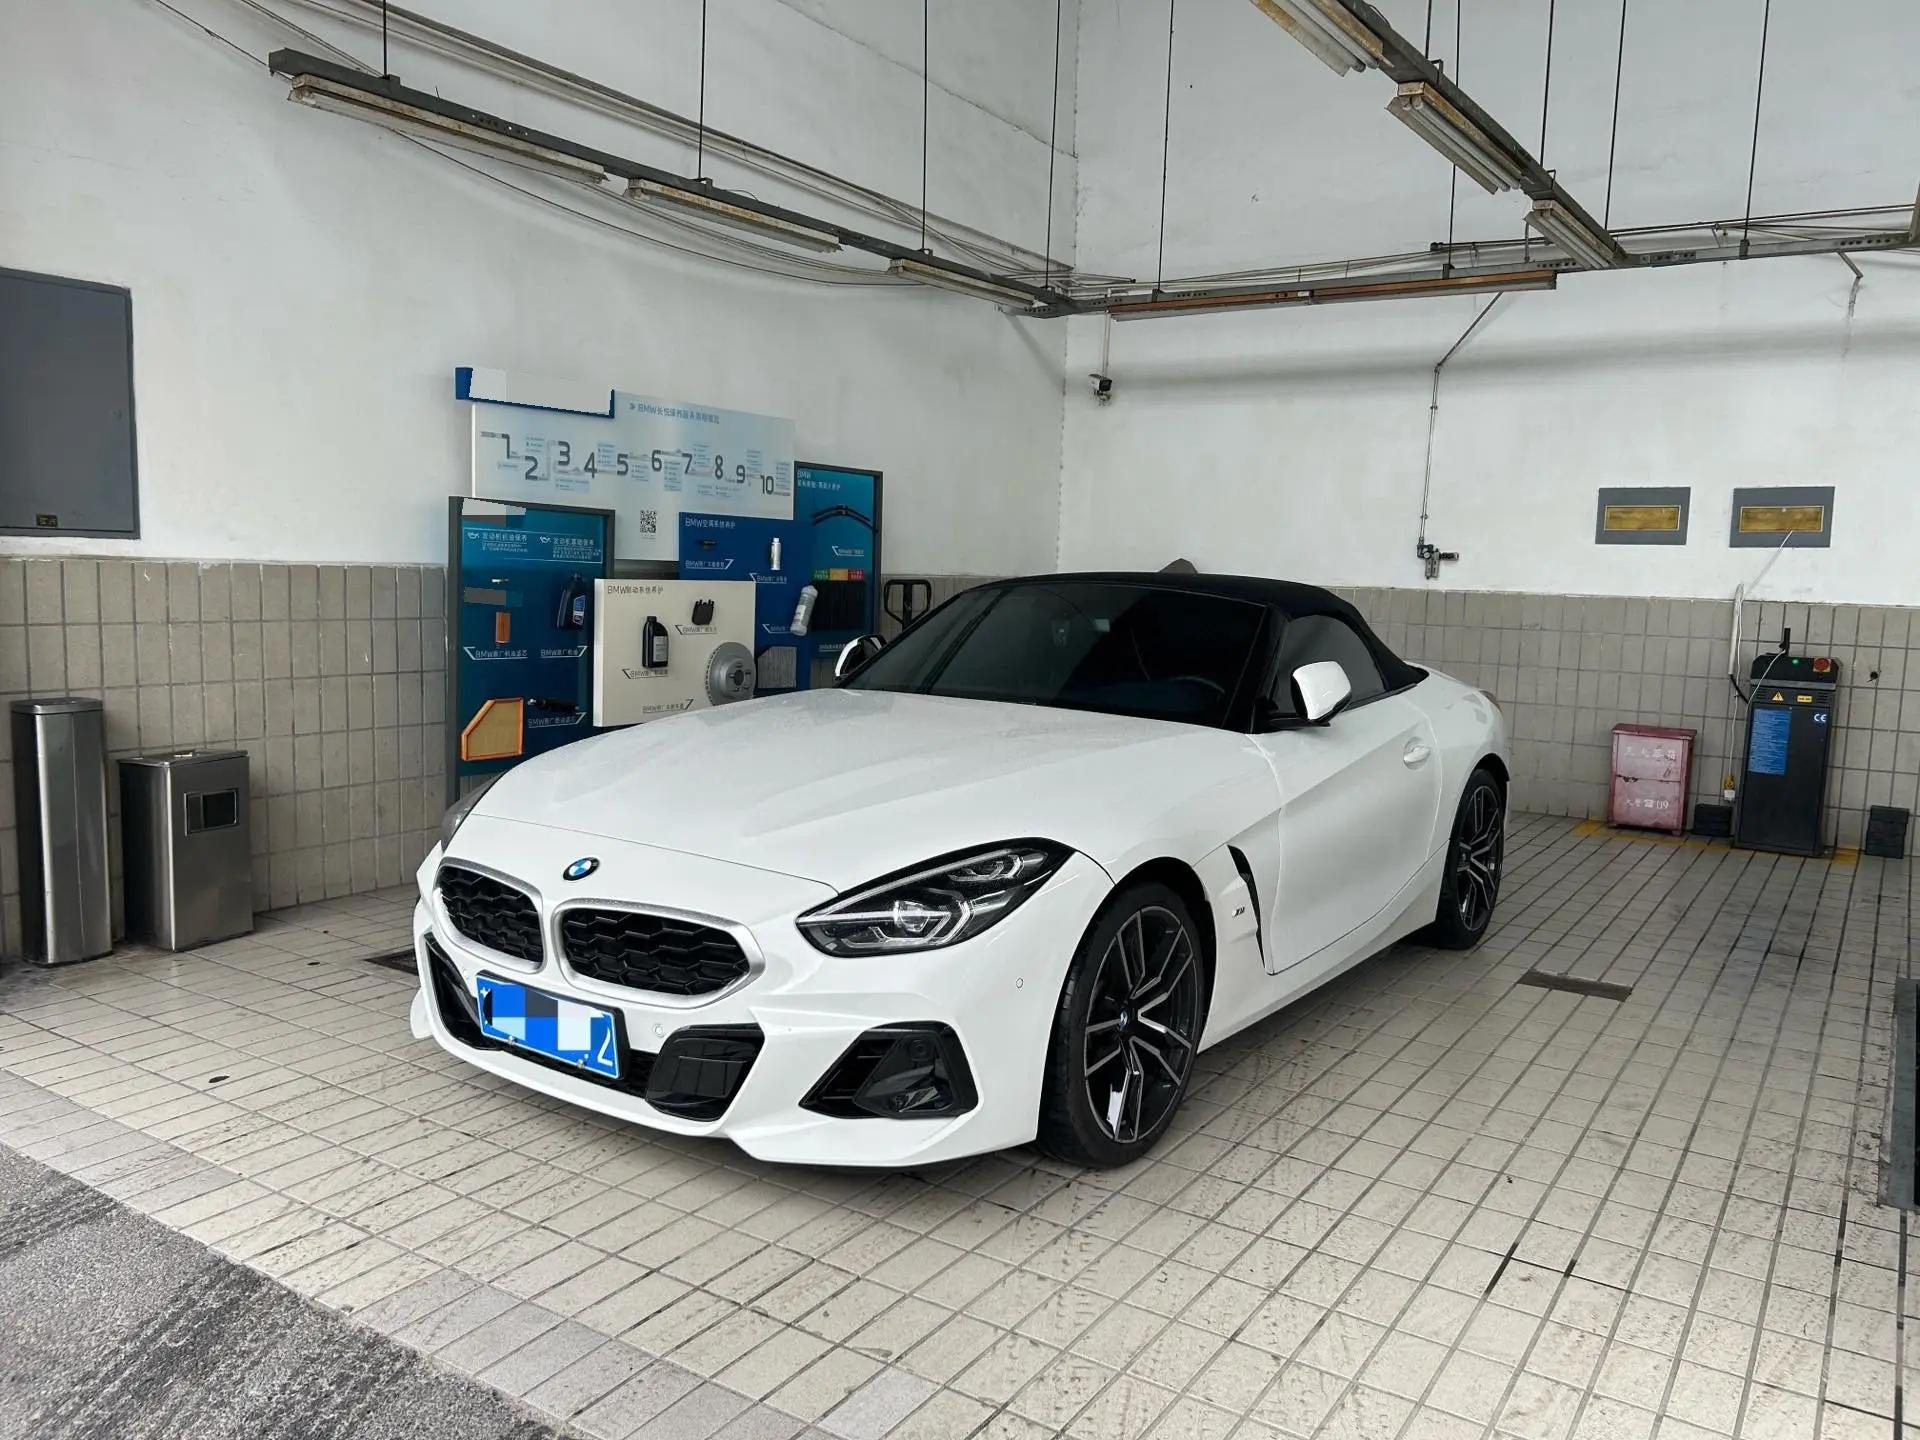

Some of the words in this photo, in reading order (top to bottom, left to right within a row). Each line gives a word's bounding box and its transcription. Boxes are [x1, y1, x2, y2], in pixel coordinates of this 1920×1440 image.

[525, 455, 539, 480] 2
[558, 441, 570, 466] 3
[584, 452, 597, 478] 4
[617, 453, 629, 476] 5
[651, 450, 662, 472] 6
[681, 453, 693, 475] 7
[715, 454, 724, 480] 8
[736, 464, 746, 483] 9
[760, 475, 774, 495] 10
[1813, 713, 1827, 722] CE
